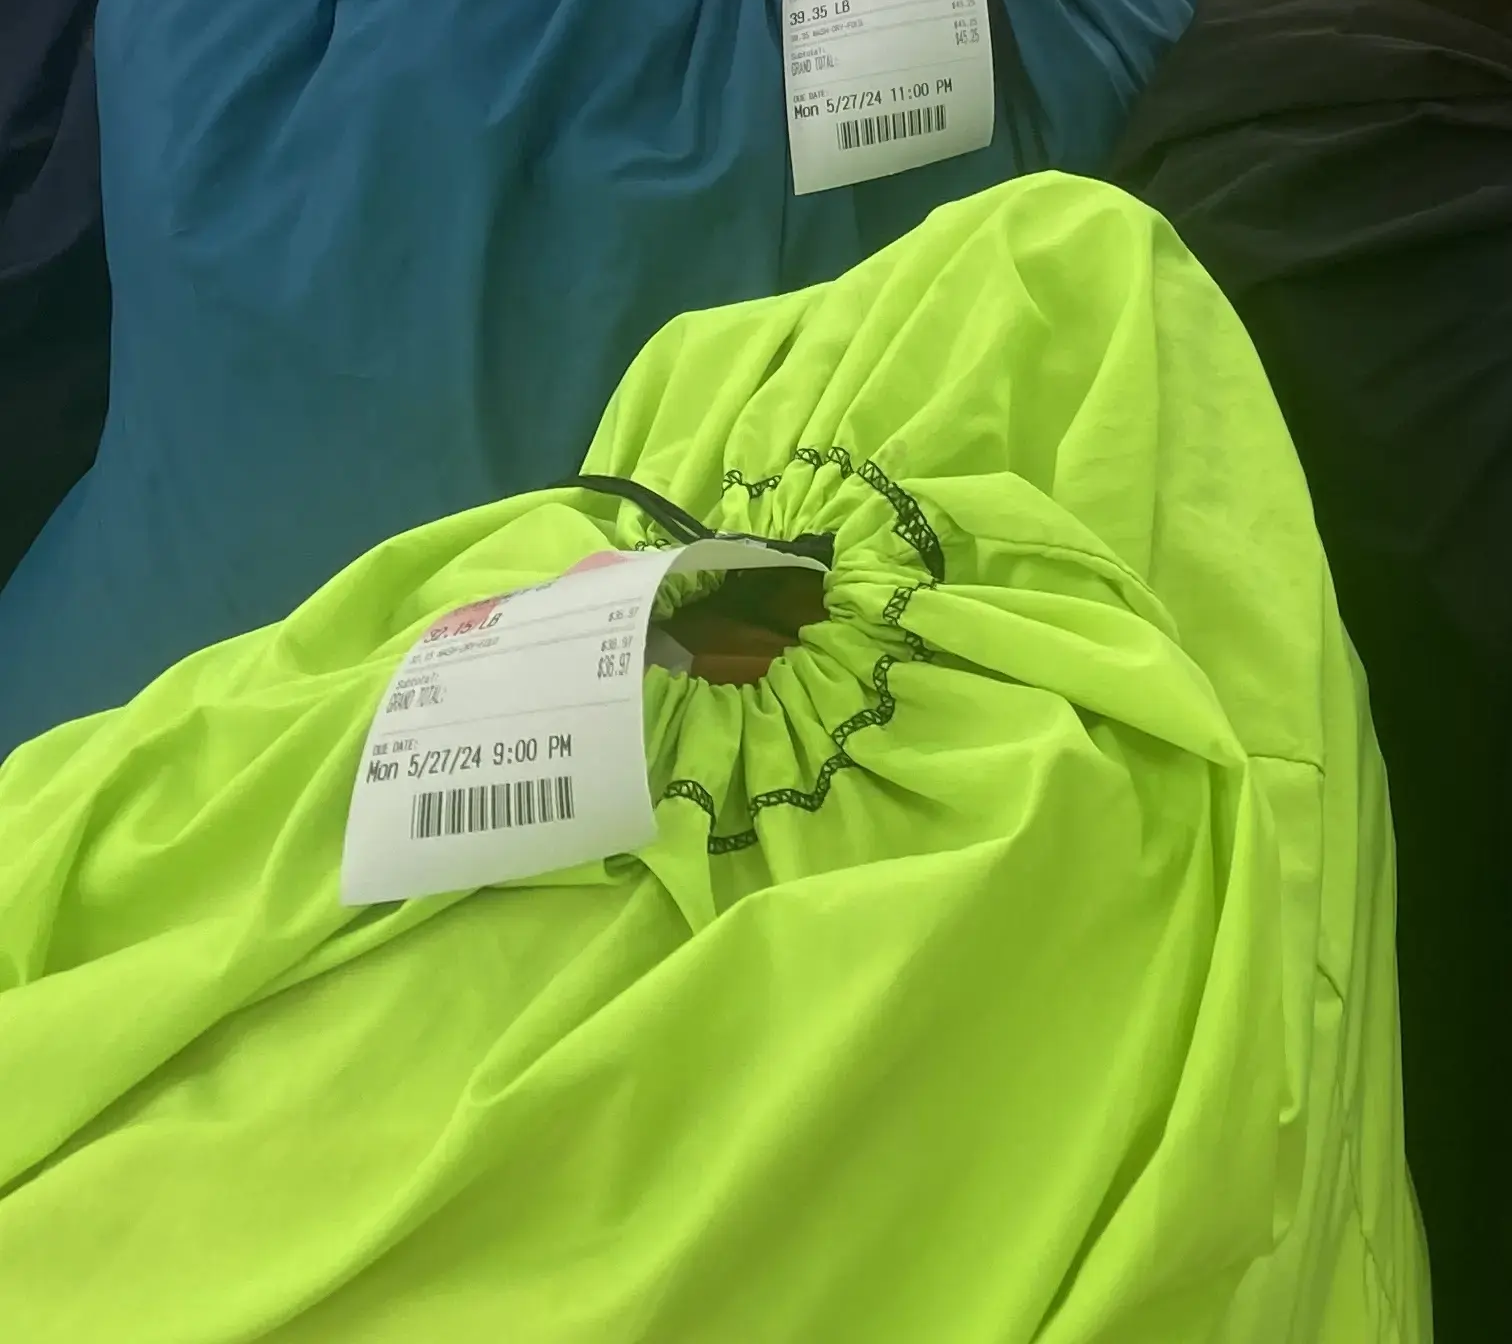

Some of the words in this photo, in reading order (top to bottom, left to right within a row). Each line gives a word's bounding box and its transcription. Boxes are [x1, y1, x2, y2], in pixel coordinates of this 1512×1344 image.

[789, 4, 828, 26] 39.35
[834, 0, 851, 15] LB
[791, 57, 812, 77] GRAND
[794, 103, 819, 120] Mon
[826, 89, 883, 114] 5/27/24
[890, 82, 930, 102] 11:00
[936, 77, 954, 95] PM
[479, 612, 503, 630] LB
[372, 741, 390, 756] DUE
[393, 737, 419, 753] DATE:
[366, 759, 399, 784] Mon
[407, 744, 482, 779] 5/27/24
[492, 737, 538, 765] 9:00
[548, 733, 572, 759] PM
